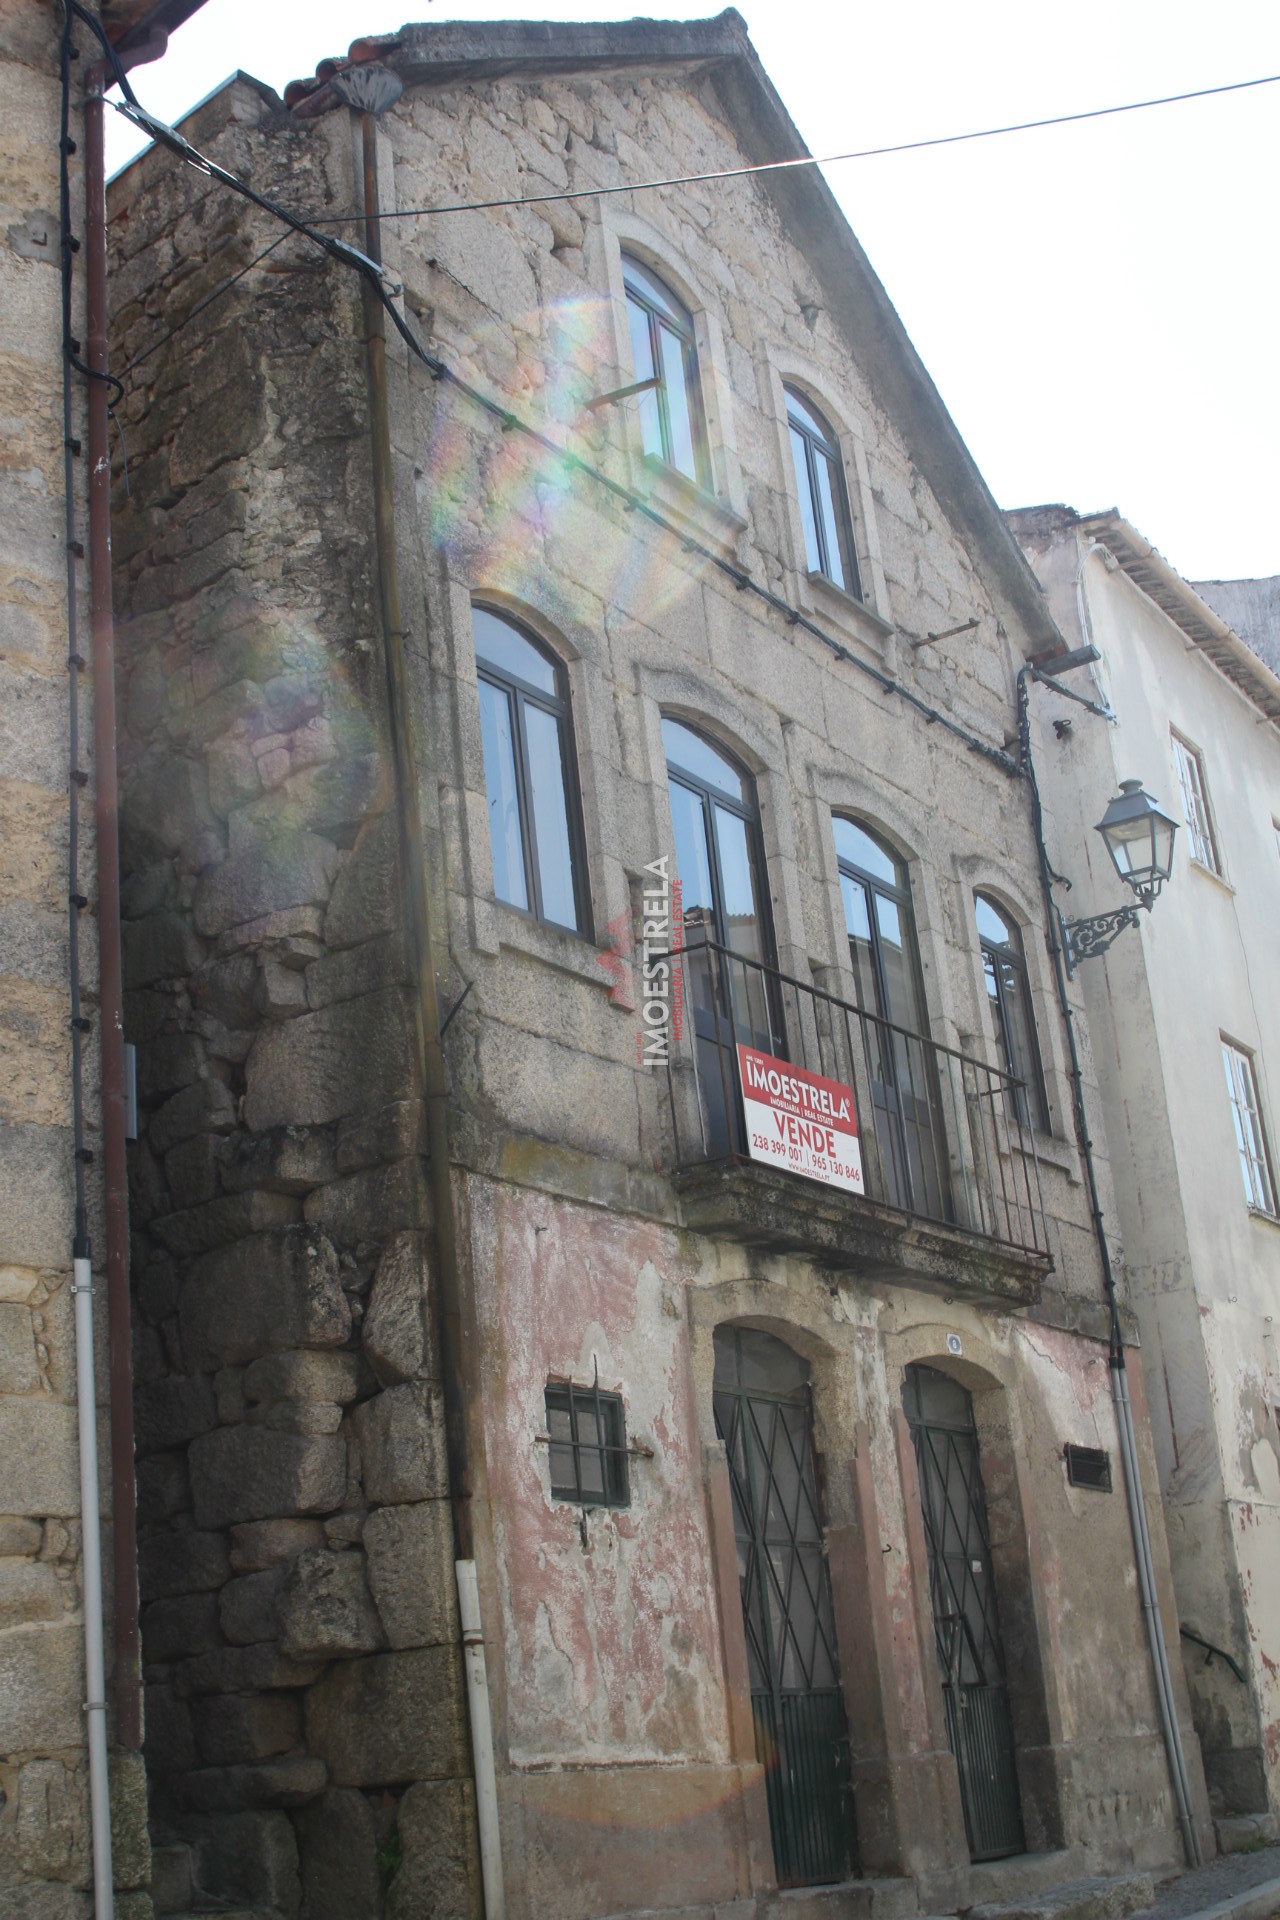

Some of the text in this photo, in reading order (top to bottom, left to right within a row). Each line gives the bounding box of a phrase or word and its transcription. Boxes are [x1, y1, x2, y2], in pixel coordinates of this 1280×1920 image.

[773, 1111, 836, 1158] VENDE
[817, 1113, 834, 1127] ESTATE
[752, 1134, 860, 1181] 238 399 001 965 130 846
